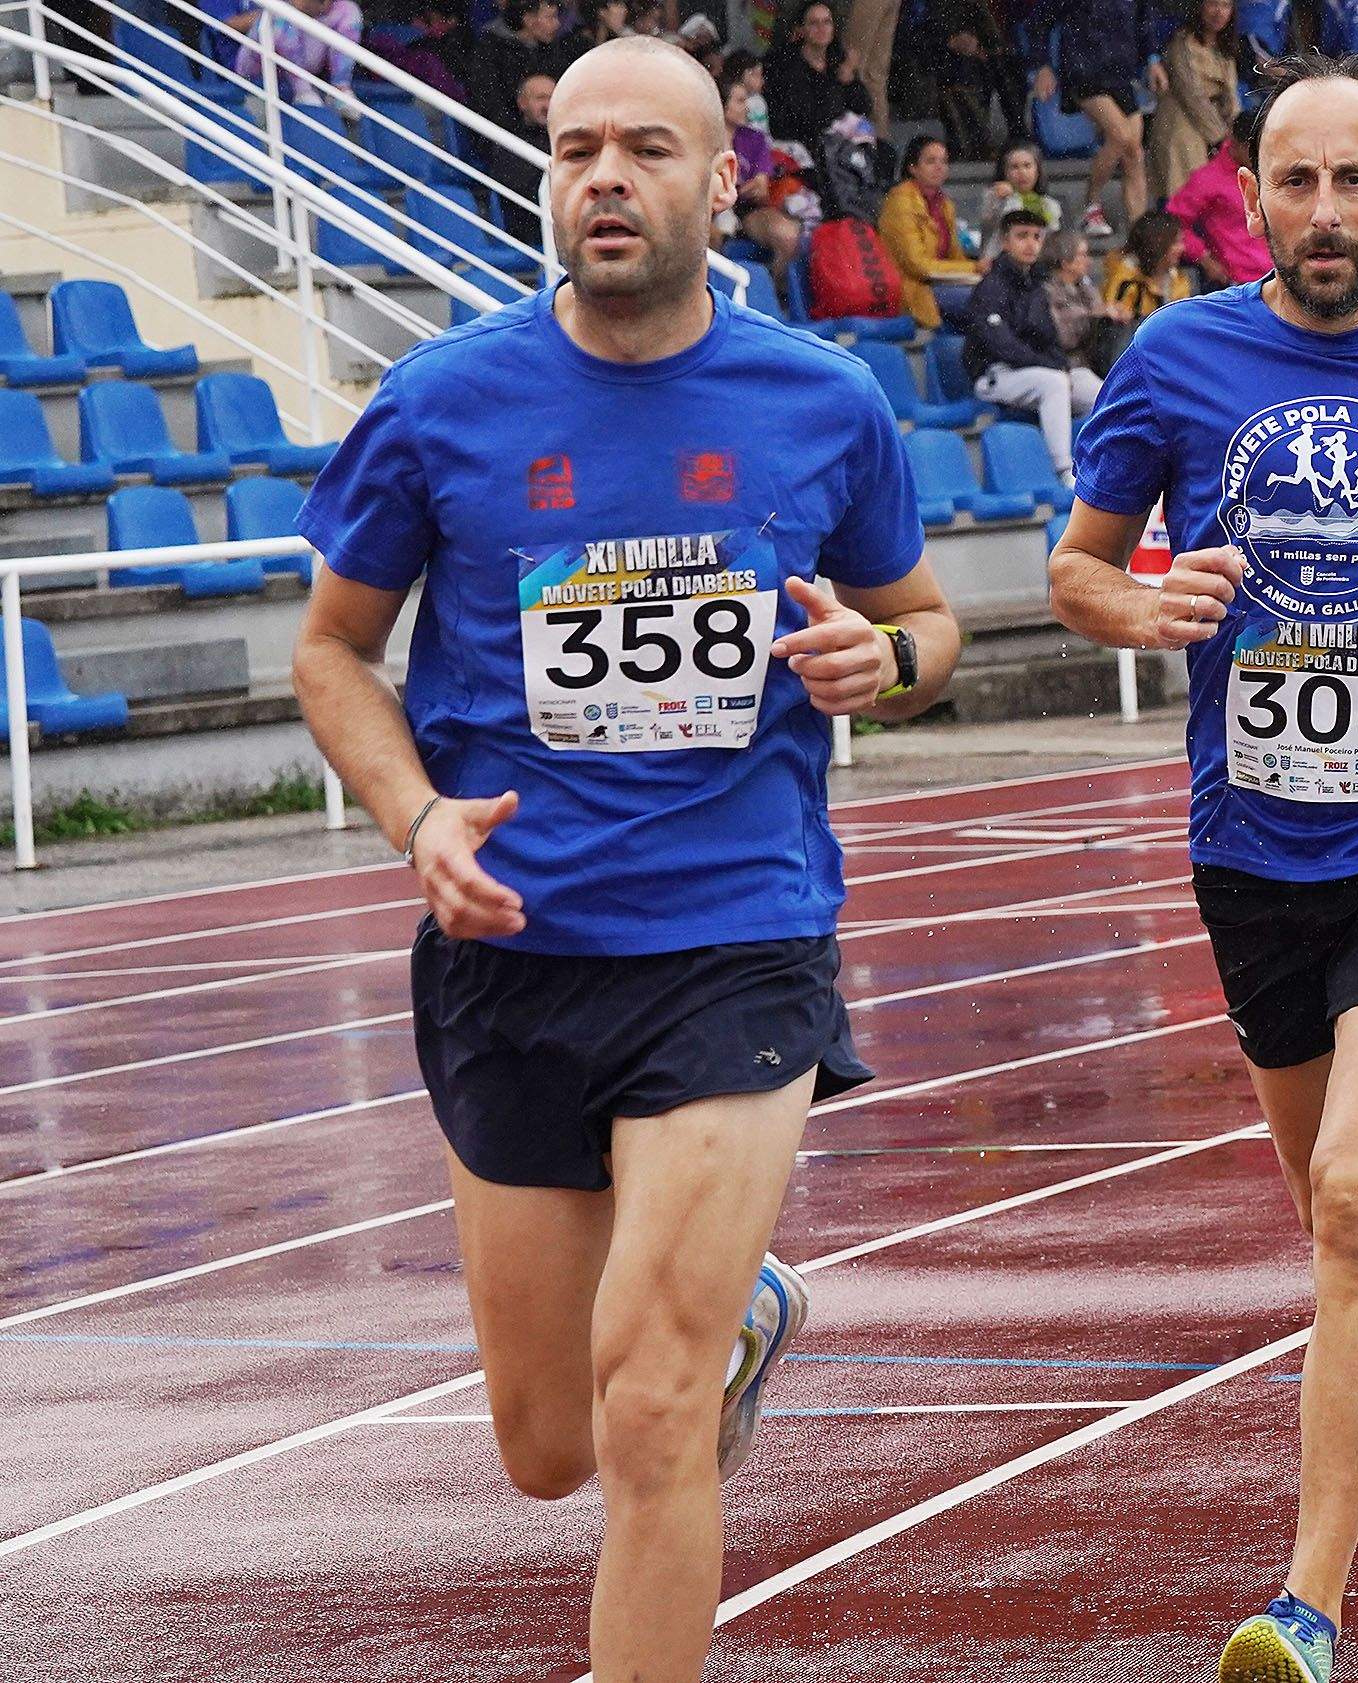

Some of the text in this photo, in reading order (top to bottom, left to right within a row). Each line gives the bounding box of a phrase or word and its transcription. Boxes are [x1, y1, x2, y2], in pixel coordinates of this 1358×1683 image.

[1227, 416, 1282, 499] MÓVETE
[1284, 406, 1351, 427] POLA
[585, 534, 718, 575] XI MILLA
[1270, 550, 1280, 560] 11
[1284, 550, 1321, 561] millas
[1326, 553, 1347, 562] sen
[542, 569, 757, 606] MÓVETE POLA DIABETES
[1262, 584, 1316, 616] ANEDIA
[546, 599, 756, 690] 358
[1277, 621, 1302, 646] XI
[1240, 649, 1301, 668] MÓVETE
[1303, 653, 1343, 670] POLA
[658, 700, 687, 712] FROIZ
[1277, 743, 1293, 751] José
[1294, 745, 1323, 754] Manuel
[1324, 747, 1352, 755] Poceiro
[1324, 761, 1349, 771] FROIZ
